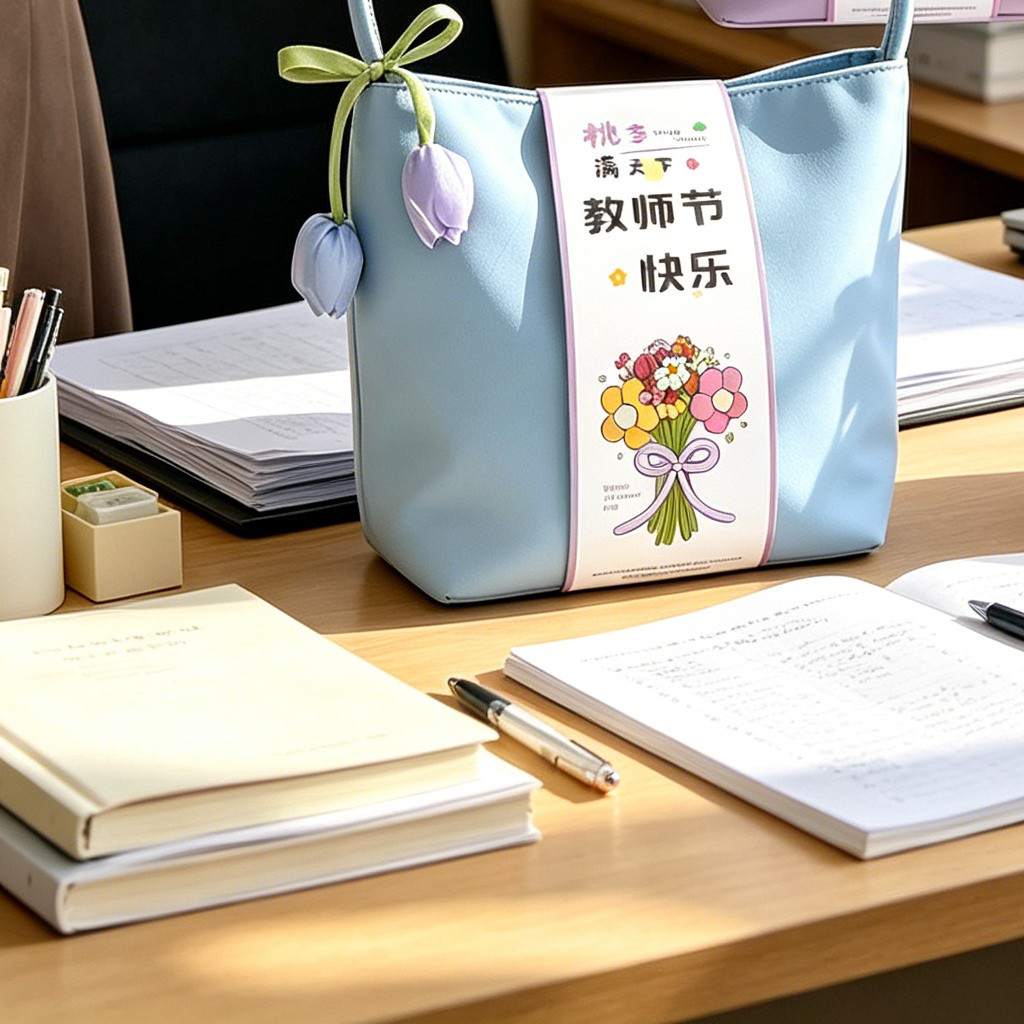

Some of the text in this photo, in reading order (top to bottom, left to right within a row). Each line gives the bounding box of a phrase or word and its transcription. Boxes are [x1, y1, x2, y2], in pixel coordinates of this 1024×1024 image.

[583, 188, 724, 235] 教师节
[640, 249, 734, 293] 快乐
